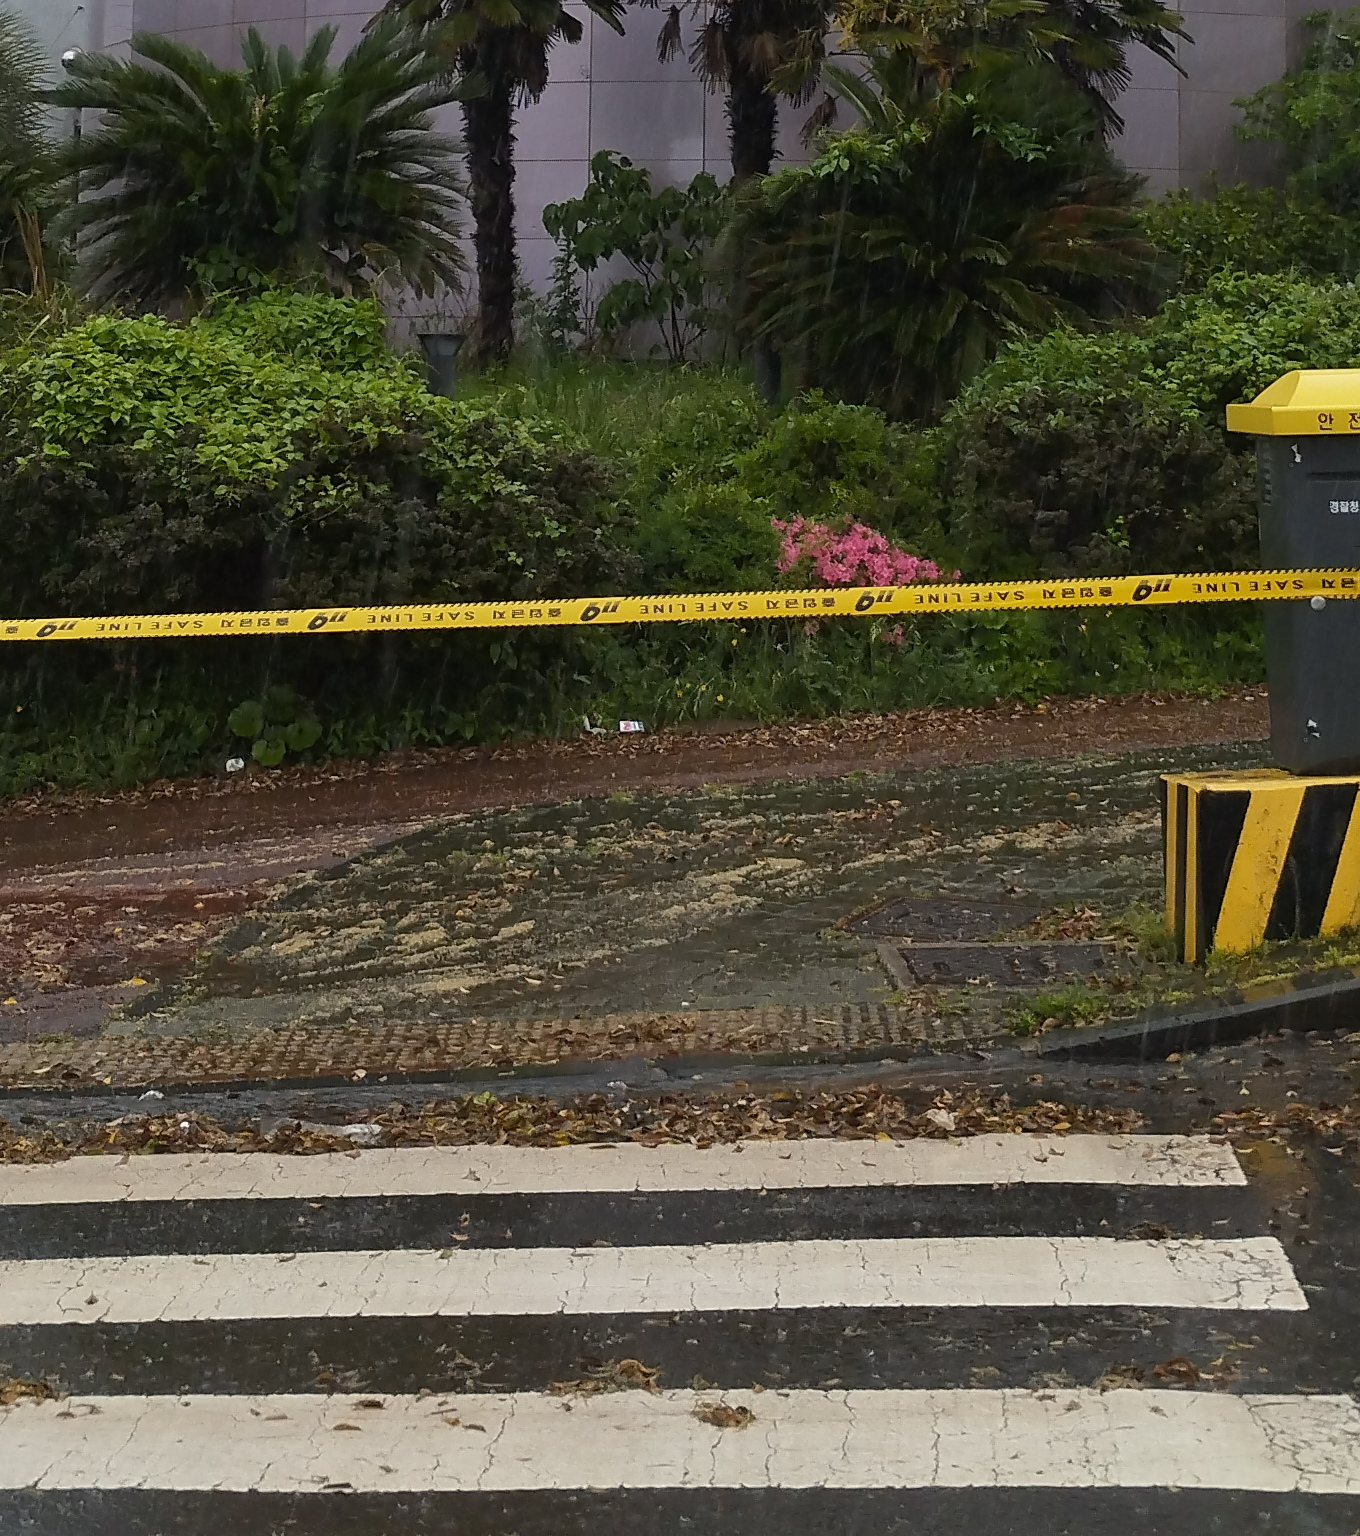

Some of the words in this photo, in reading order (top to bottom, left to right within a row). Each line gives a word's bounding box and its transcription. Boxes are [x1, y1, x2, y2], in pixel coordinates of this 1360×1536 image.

[1329, 499, 1359, 513] 경찰청
[1192, 580, 1240, 593] LINE
[1249, 579, 1304, 591] SAFE
[914, 593, 962, 604] LINE
[970, 590, 1025, 602] SAFE
[639, 604, 686, 614] LINE
[695, 601, 749, 612] SAFE
[367, 614, 413, 624] LINE
[422, 611, 475, 621] SAFE
[96, 622, 142, 632] LINE
[150, 620, 204, 630] SAFE
